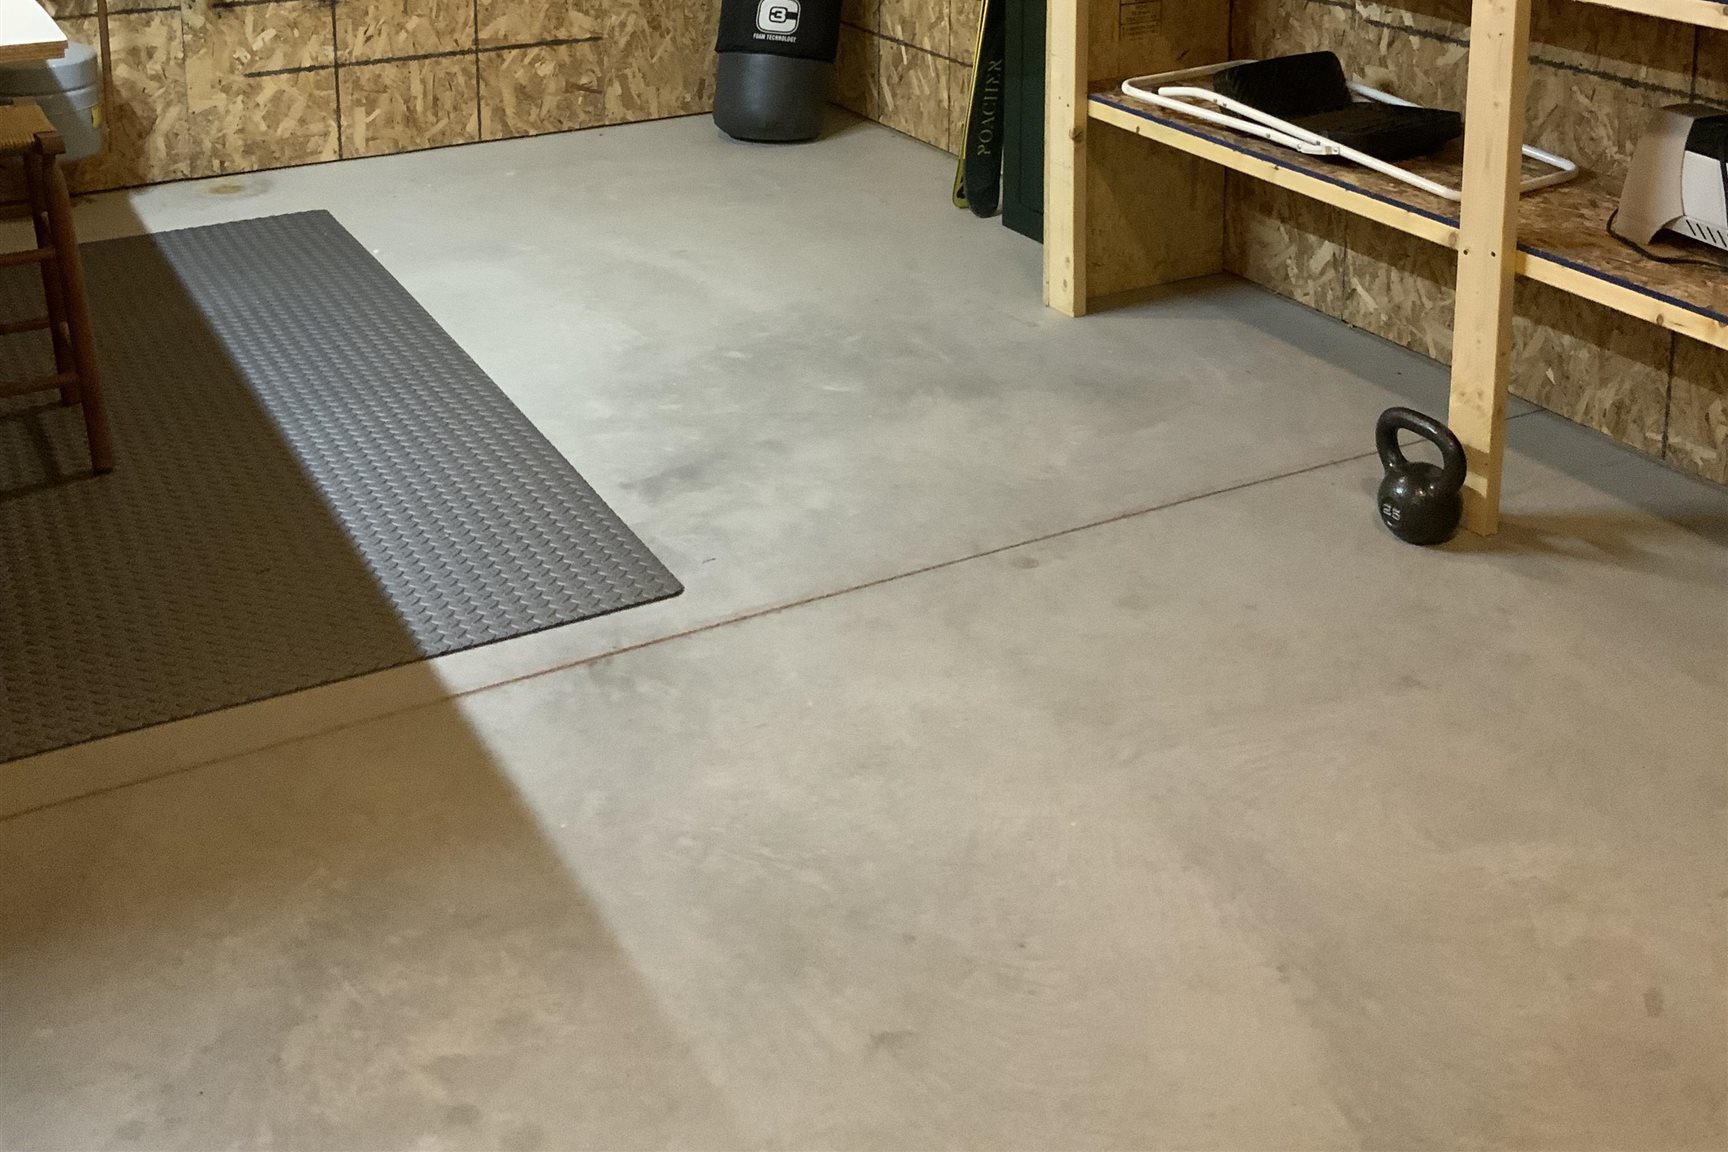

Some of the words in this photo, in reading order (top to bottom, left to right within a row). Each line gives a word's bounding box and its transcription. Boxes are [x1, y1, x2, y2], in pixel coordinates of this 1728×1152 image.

[752, 32, 766, 40] FOAM
[766, 34, 797, 43] TECHNOLOGY
[1382, 503, 1401, 521] 25
